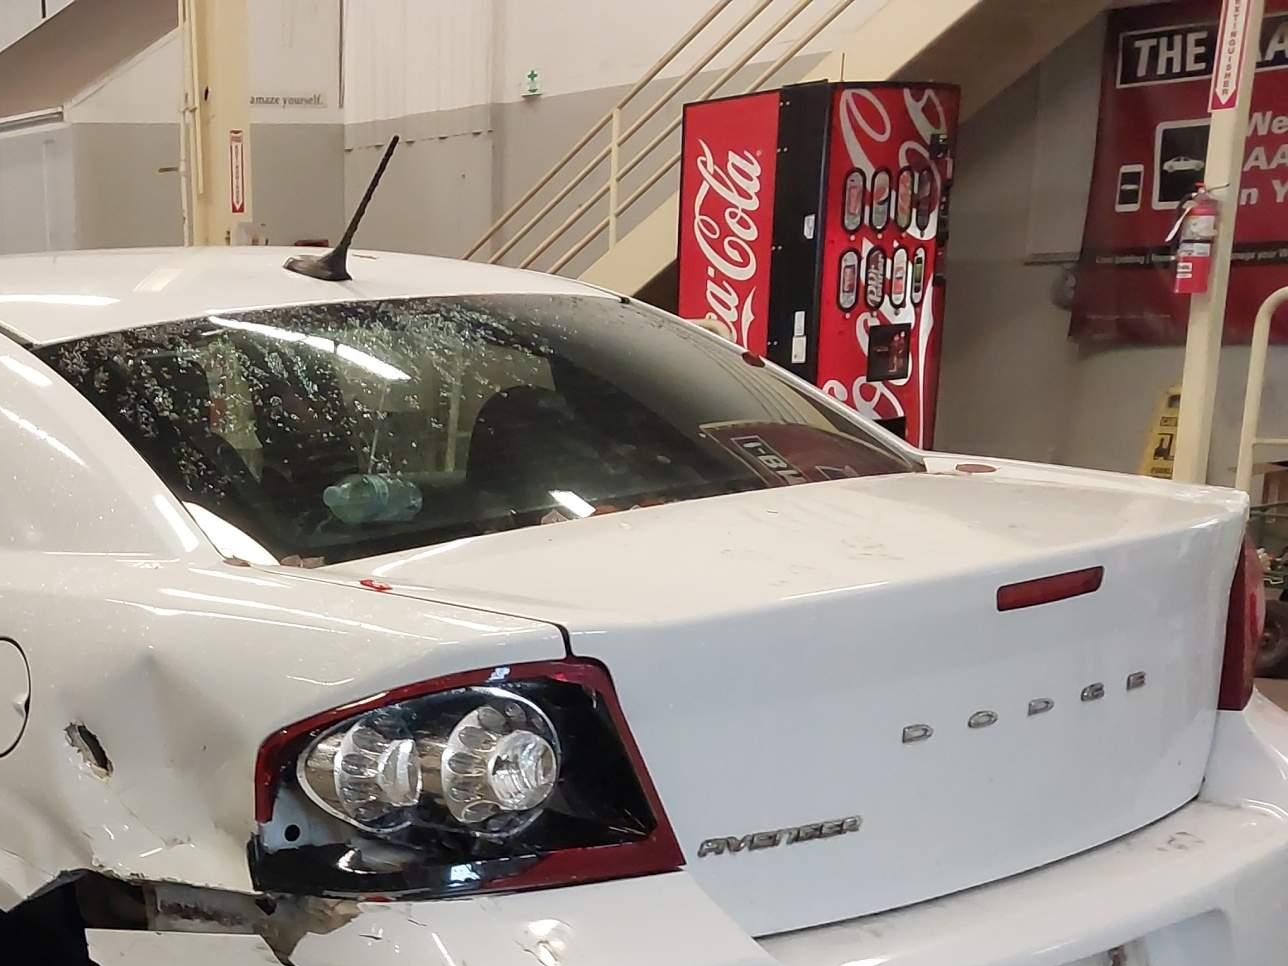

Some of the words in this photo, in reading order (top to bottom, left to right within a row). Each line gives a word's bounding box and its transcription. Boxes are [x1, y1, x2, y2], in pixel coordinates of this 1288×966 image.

[1133, 30, 1208, 78] THE
[249, 95, 280, 105] amaze
[901, 671, 1148, 745] DODGE
[697, 814, 863, 859] AVENGER
